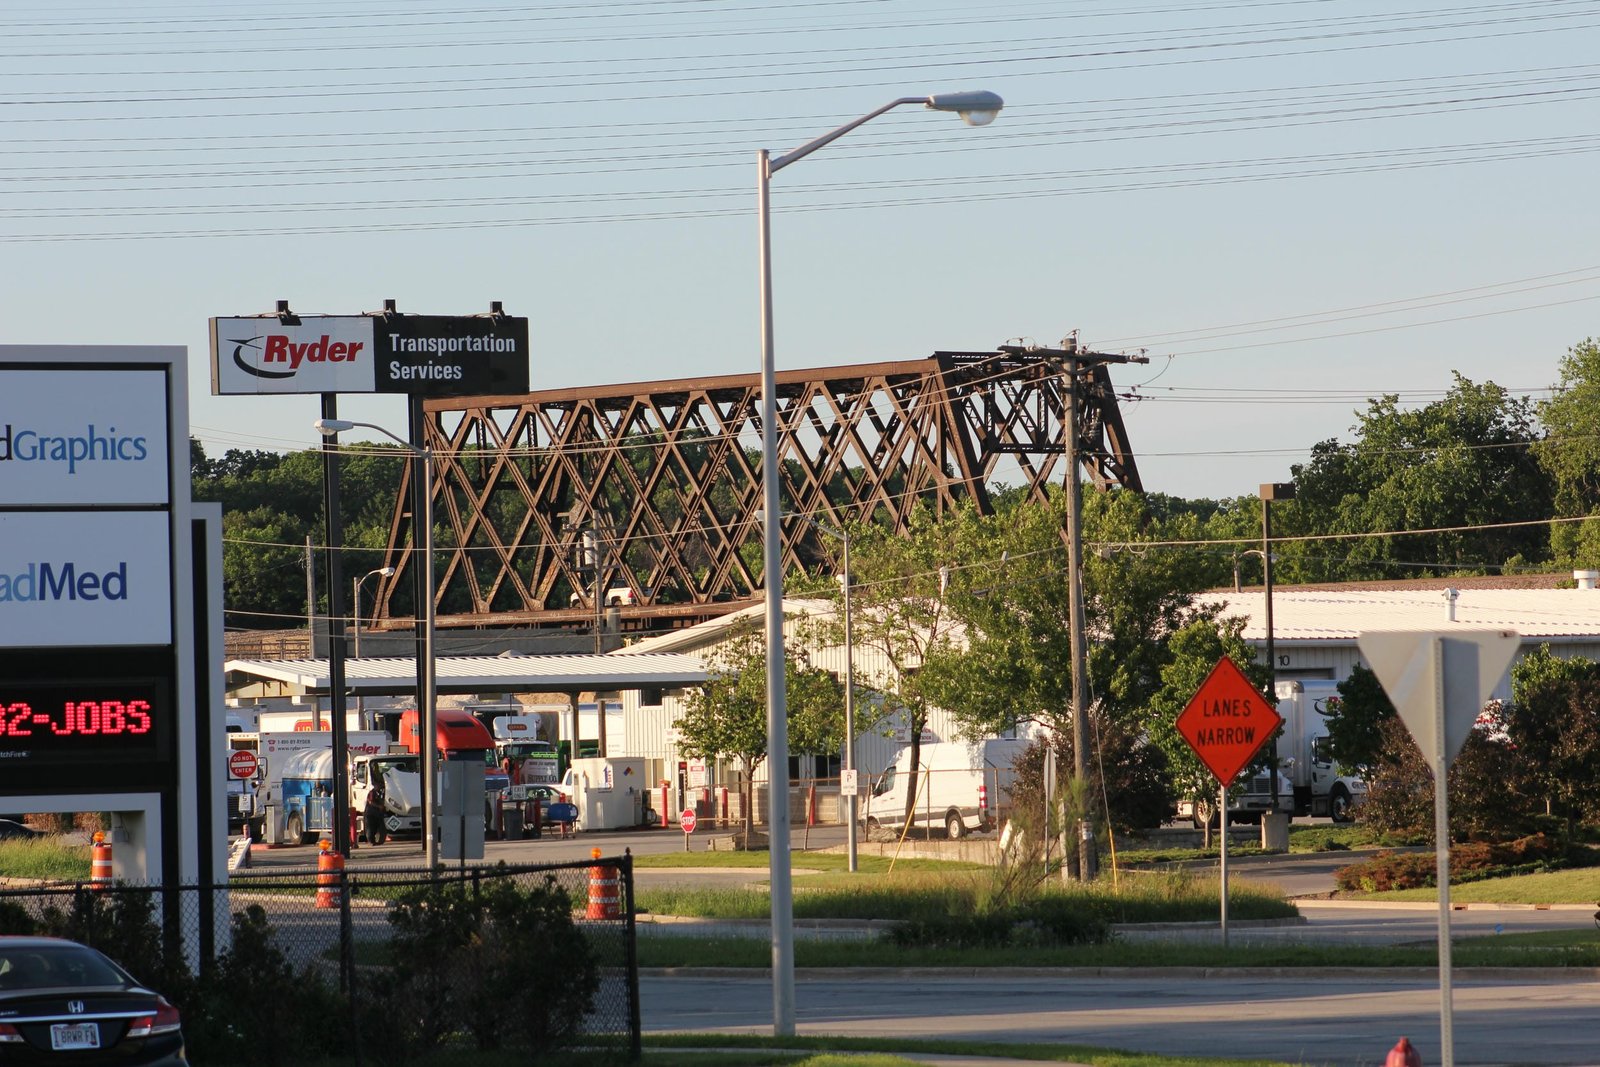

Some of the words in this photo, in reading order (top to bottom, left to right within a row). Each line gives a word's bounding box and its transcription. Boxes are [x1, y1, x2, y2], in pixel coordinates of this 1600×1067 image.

[263, 335, 364, 369] Ryder
[389, 333, 516, 356] Transportation
[390, 361, 462, 380] Services
[0, 562, 128, 601] adMed
[1278, 655, 1290, 666] 10
[1203, 699, 1251, 717] LANES
[0, 700, 150, 736] 2-JOBS
[1197, 727, 1256, 746] NARROW
[682, 816, 696, 826] STOP
